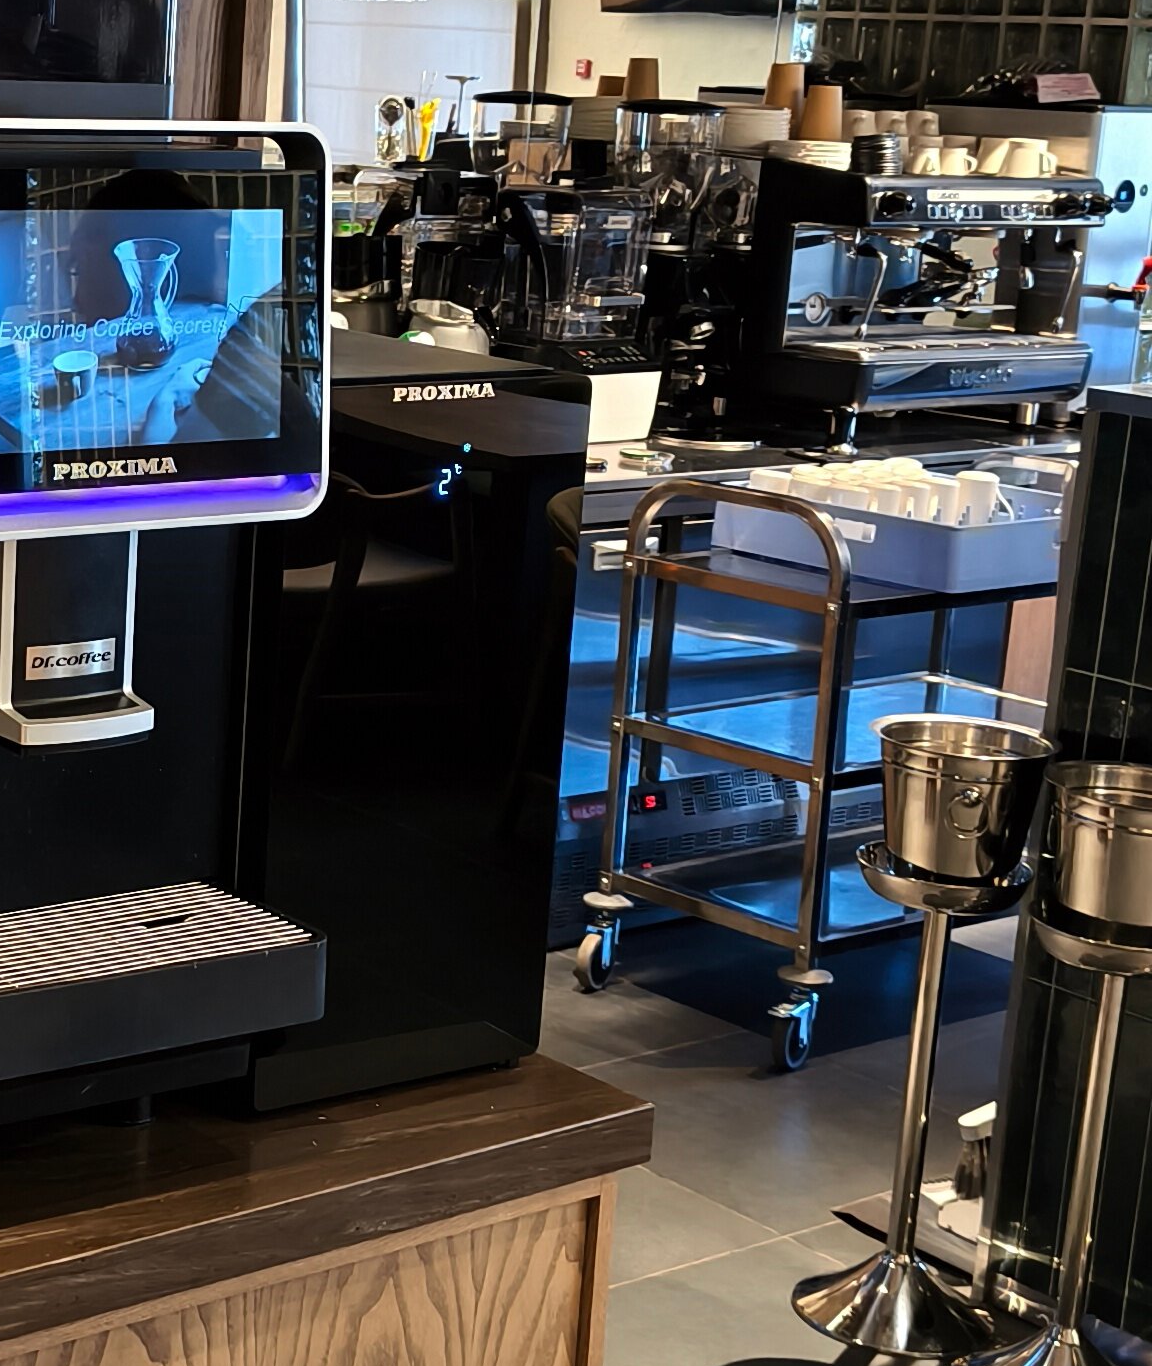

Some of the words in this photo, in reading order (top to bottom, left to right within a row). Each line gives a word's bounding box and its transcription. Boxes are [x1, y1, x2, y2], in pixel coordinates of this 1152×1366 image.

[93, 317, 154, 337] Coffee
[163, 316, 227, 337] Secrets
[392, 382, 496, 403] PROXIMA
[53, 456, 178, 481] PROXIMA
[31, 651, 111, 669] Dr.coffee
